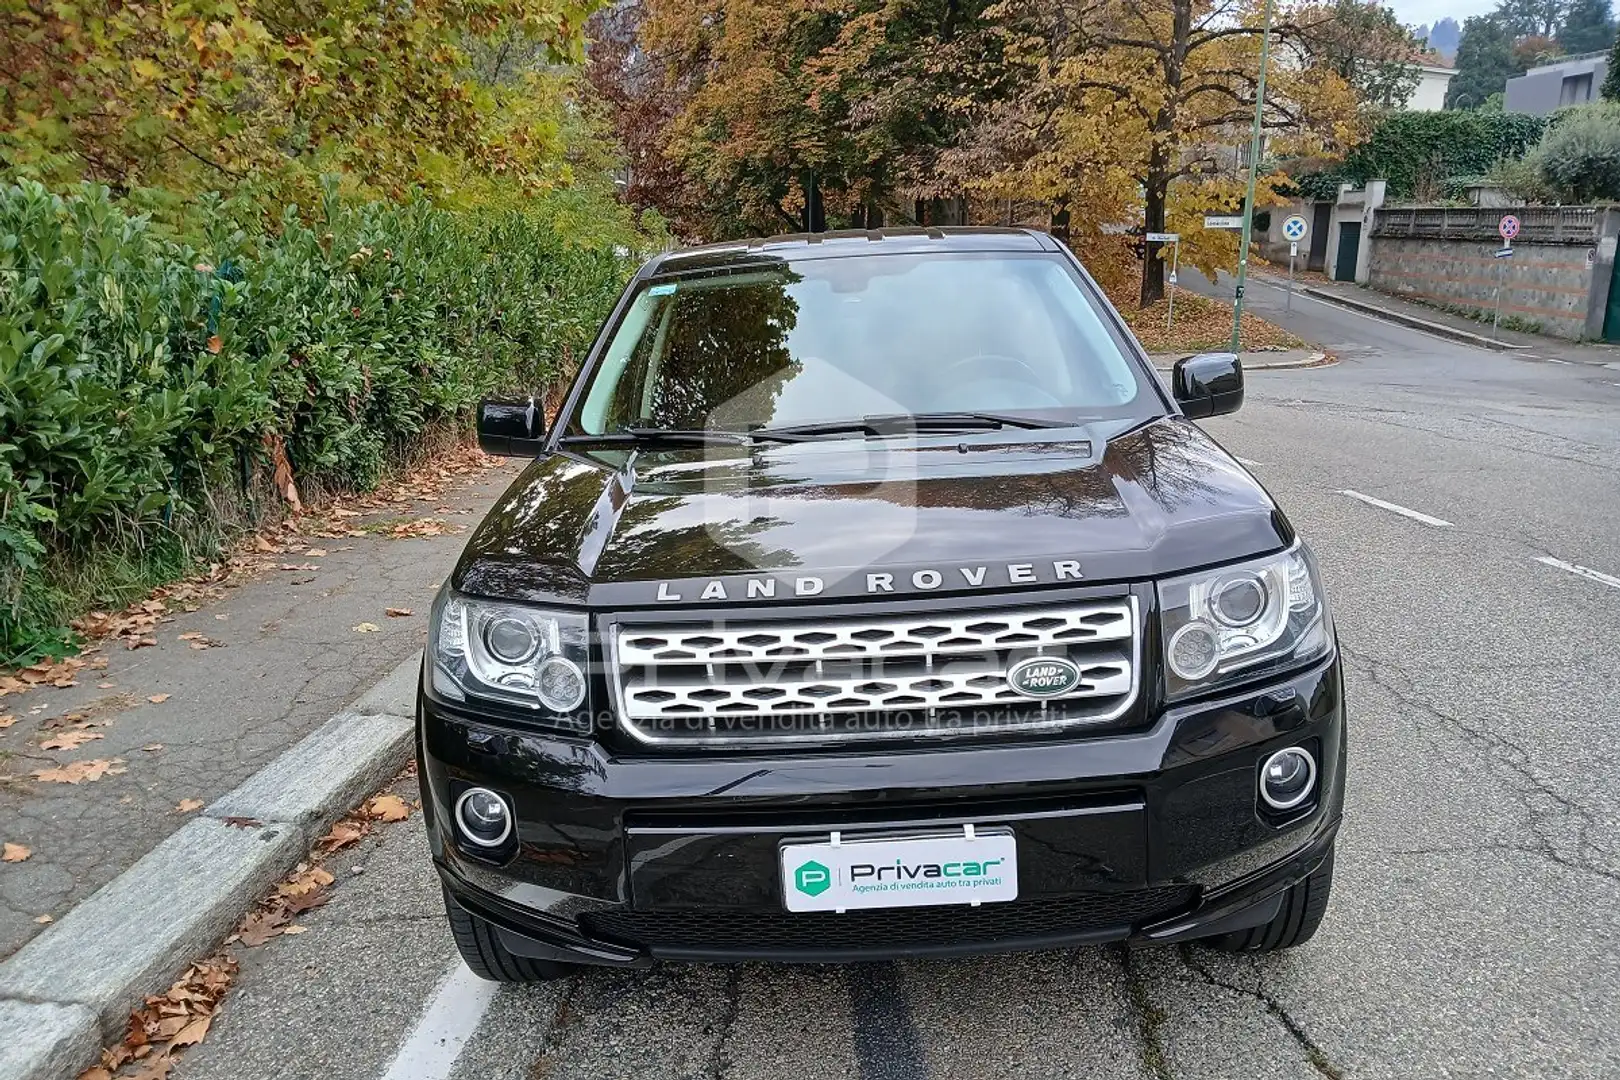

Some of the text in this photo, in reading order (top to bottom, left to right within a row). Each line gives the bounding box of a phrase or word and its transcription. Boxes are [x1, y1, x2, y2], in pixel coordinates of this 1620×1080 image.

[657, 560, 1084, 601] LAND ROVER
[851, 858, 1001, 882] Privacar
[852, 876, 1002, 894] Agenzia di vendita auto tra privati
